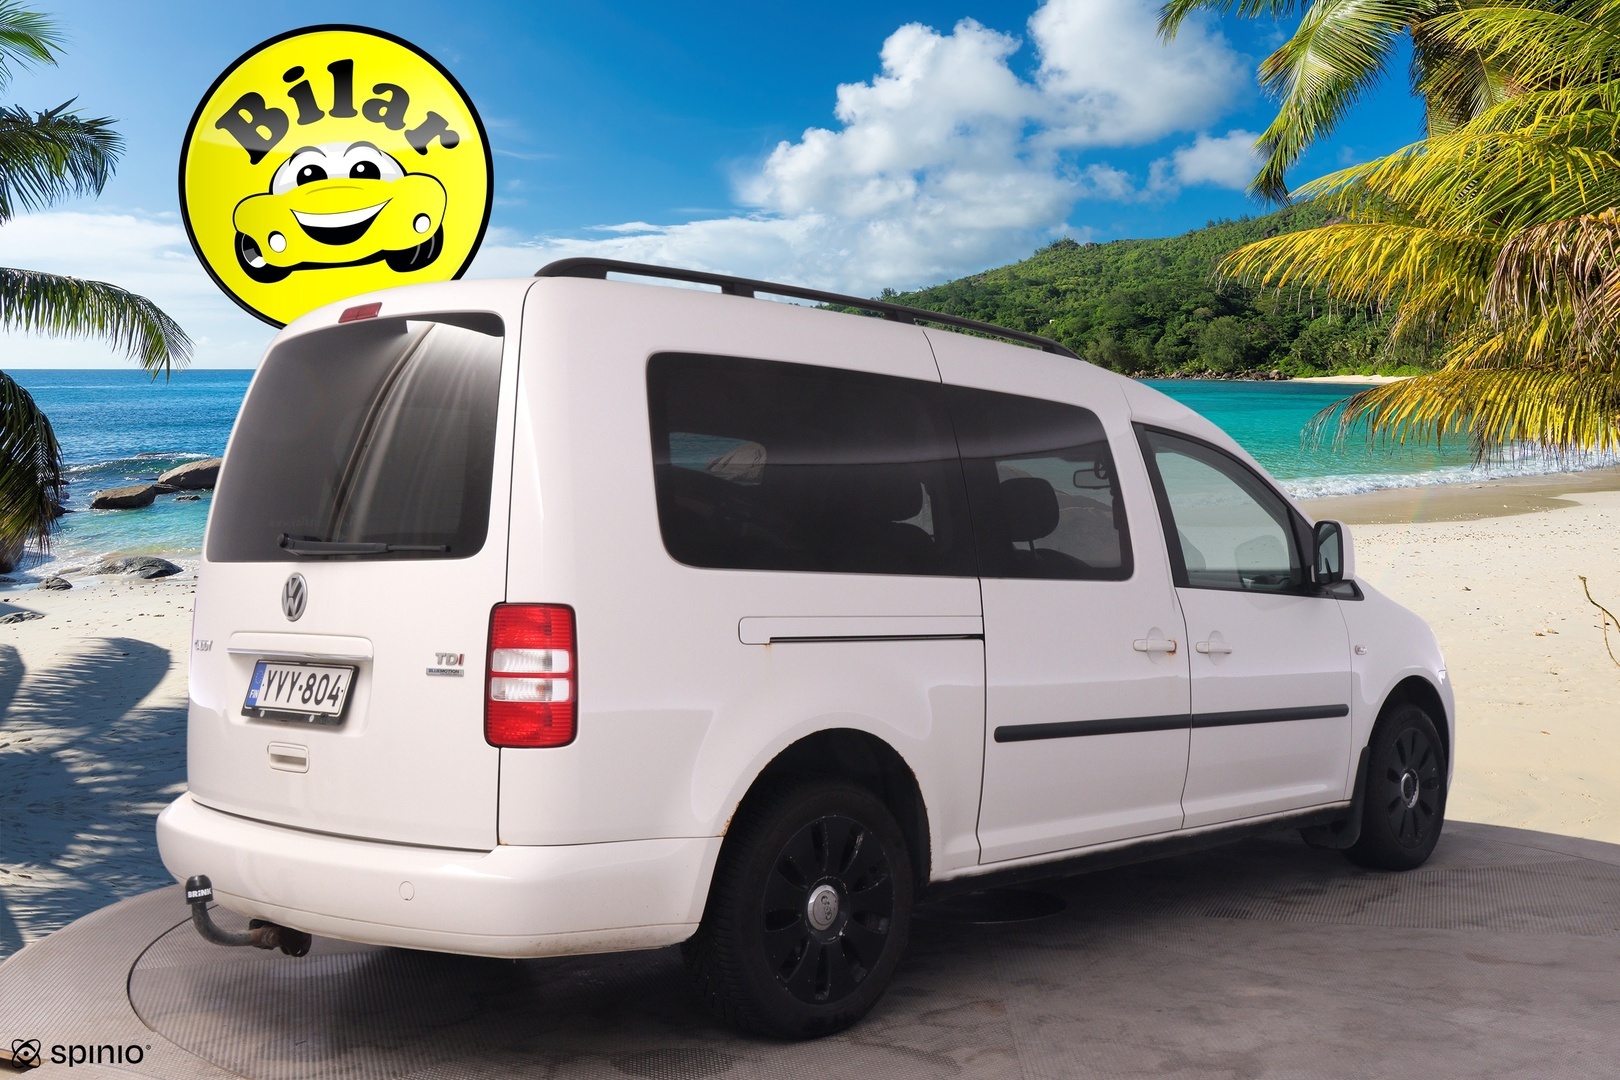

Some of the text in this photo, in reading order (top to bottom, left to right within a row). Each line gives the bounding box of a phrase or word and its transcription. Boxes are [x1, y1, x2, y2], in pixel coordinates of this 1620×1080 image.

[435, 652, 465, 666] TDI
[249, 689, 260, 699] FIN
[263, 670, 342, 707] YVY-804
